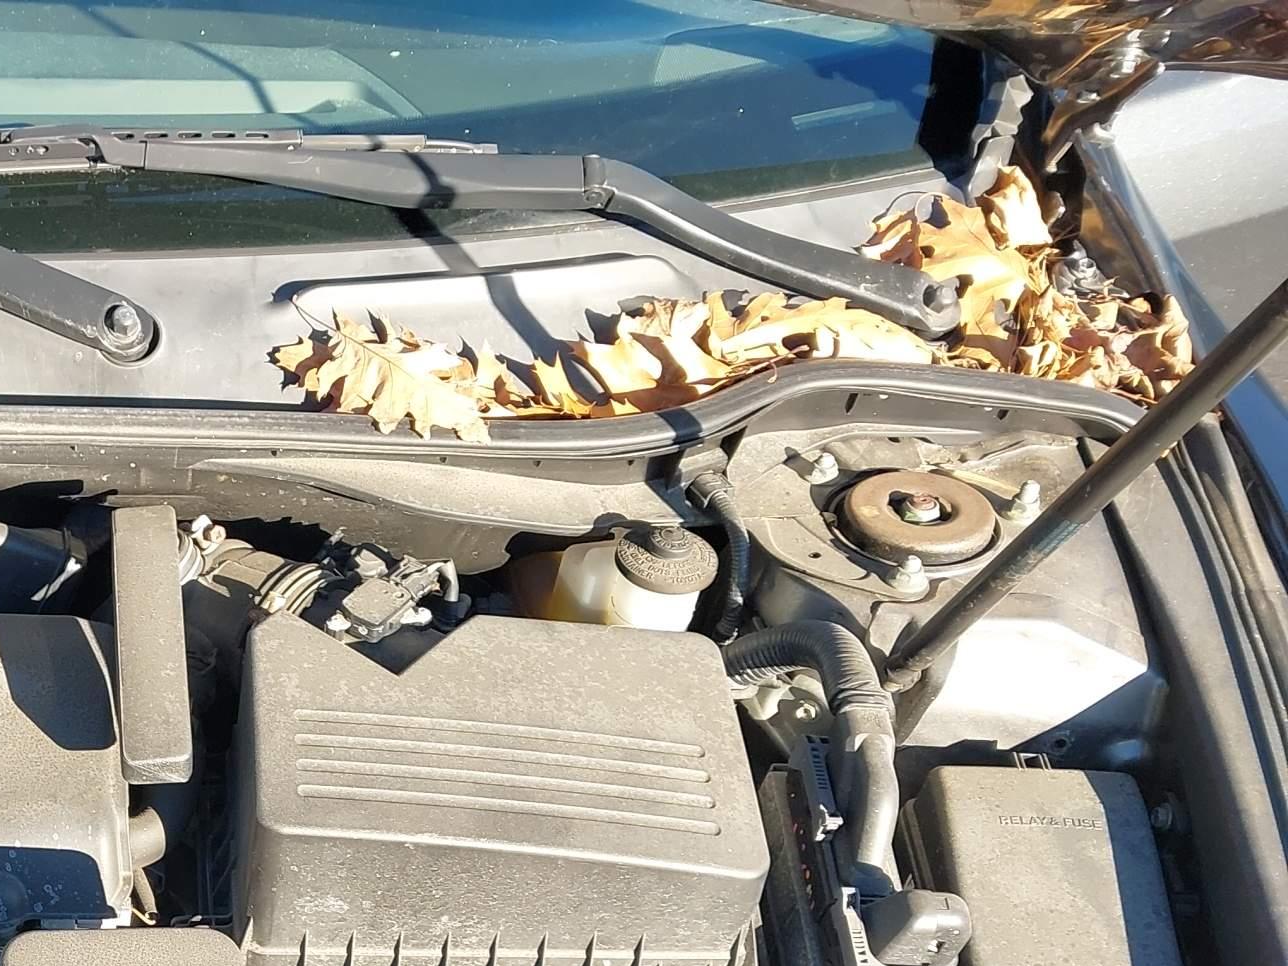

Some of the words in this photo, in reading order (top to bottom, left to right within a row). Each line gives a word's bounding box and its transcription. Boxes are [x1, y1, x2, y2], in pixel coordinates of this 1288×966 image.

[998, 815, 1047, 826] RELAY
[1049, 816, 1061, 828] &
[1063, 817, 1104, 831] FUSE
